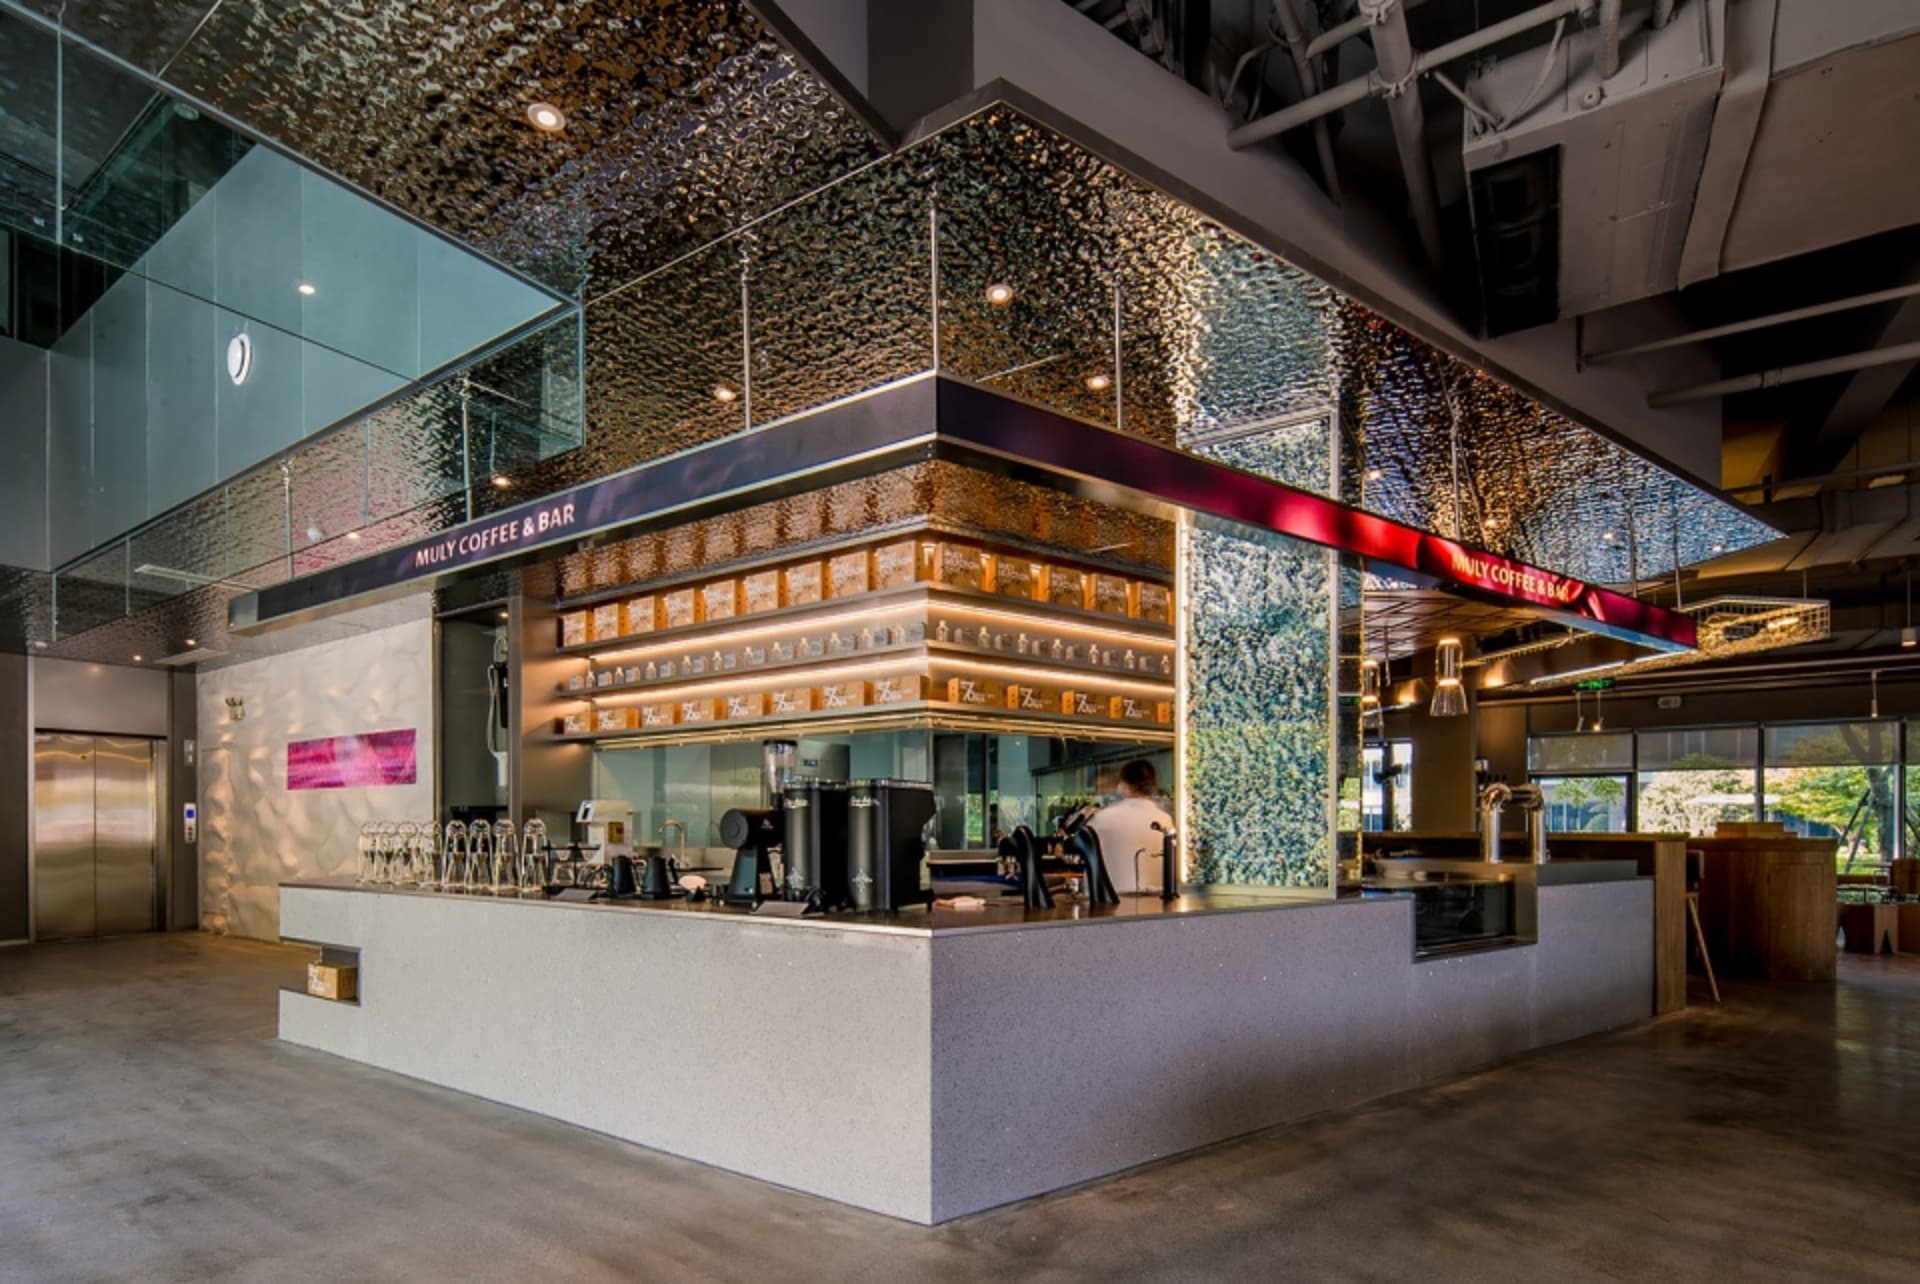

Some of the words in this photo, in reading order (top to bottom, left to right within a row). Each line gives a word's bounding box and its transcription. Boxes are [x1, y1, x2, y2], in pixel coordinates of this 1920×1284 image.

[415, 539, 457, 568] MULY
[459, 520, 519, 555] COFFEE
[522, 516, 535, 537] &
[538, 503, 575, 533] BAR
[1451, 552, 1490, 581] MULY
[1490, 564, 1537, 594] COFFEE
[1537, 578, 1546, 596] &
[1547, 582, 1570, 603] BAR
